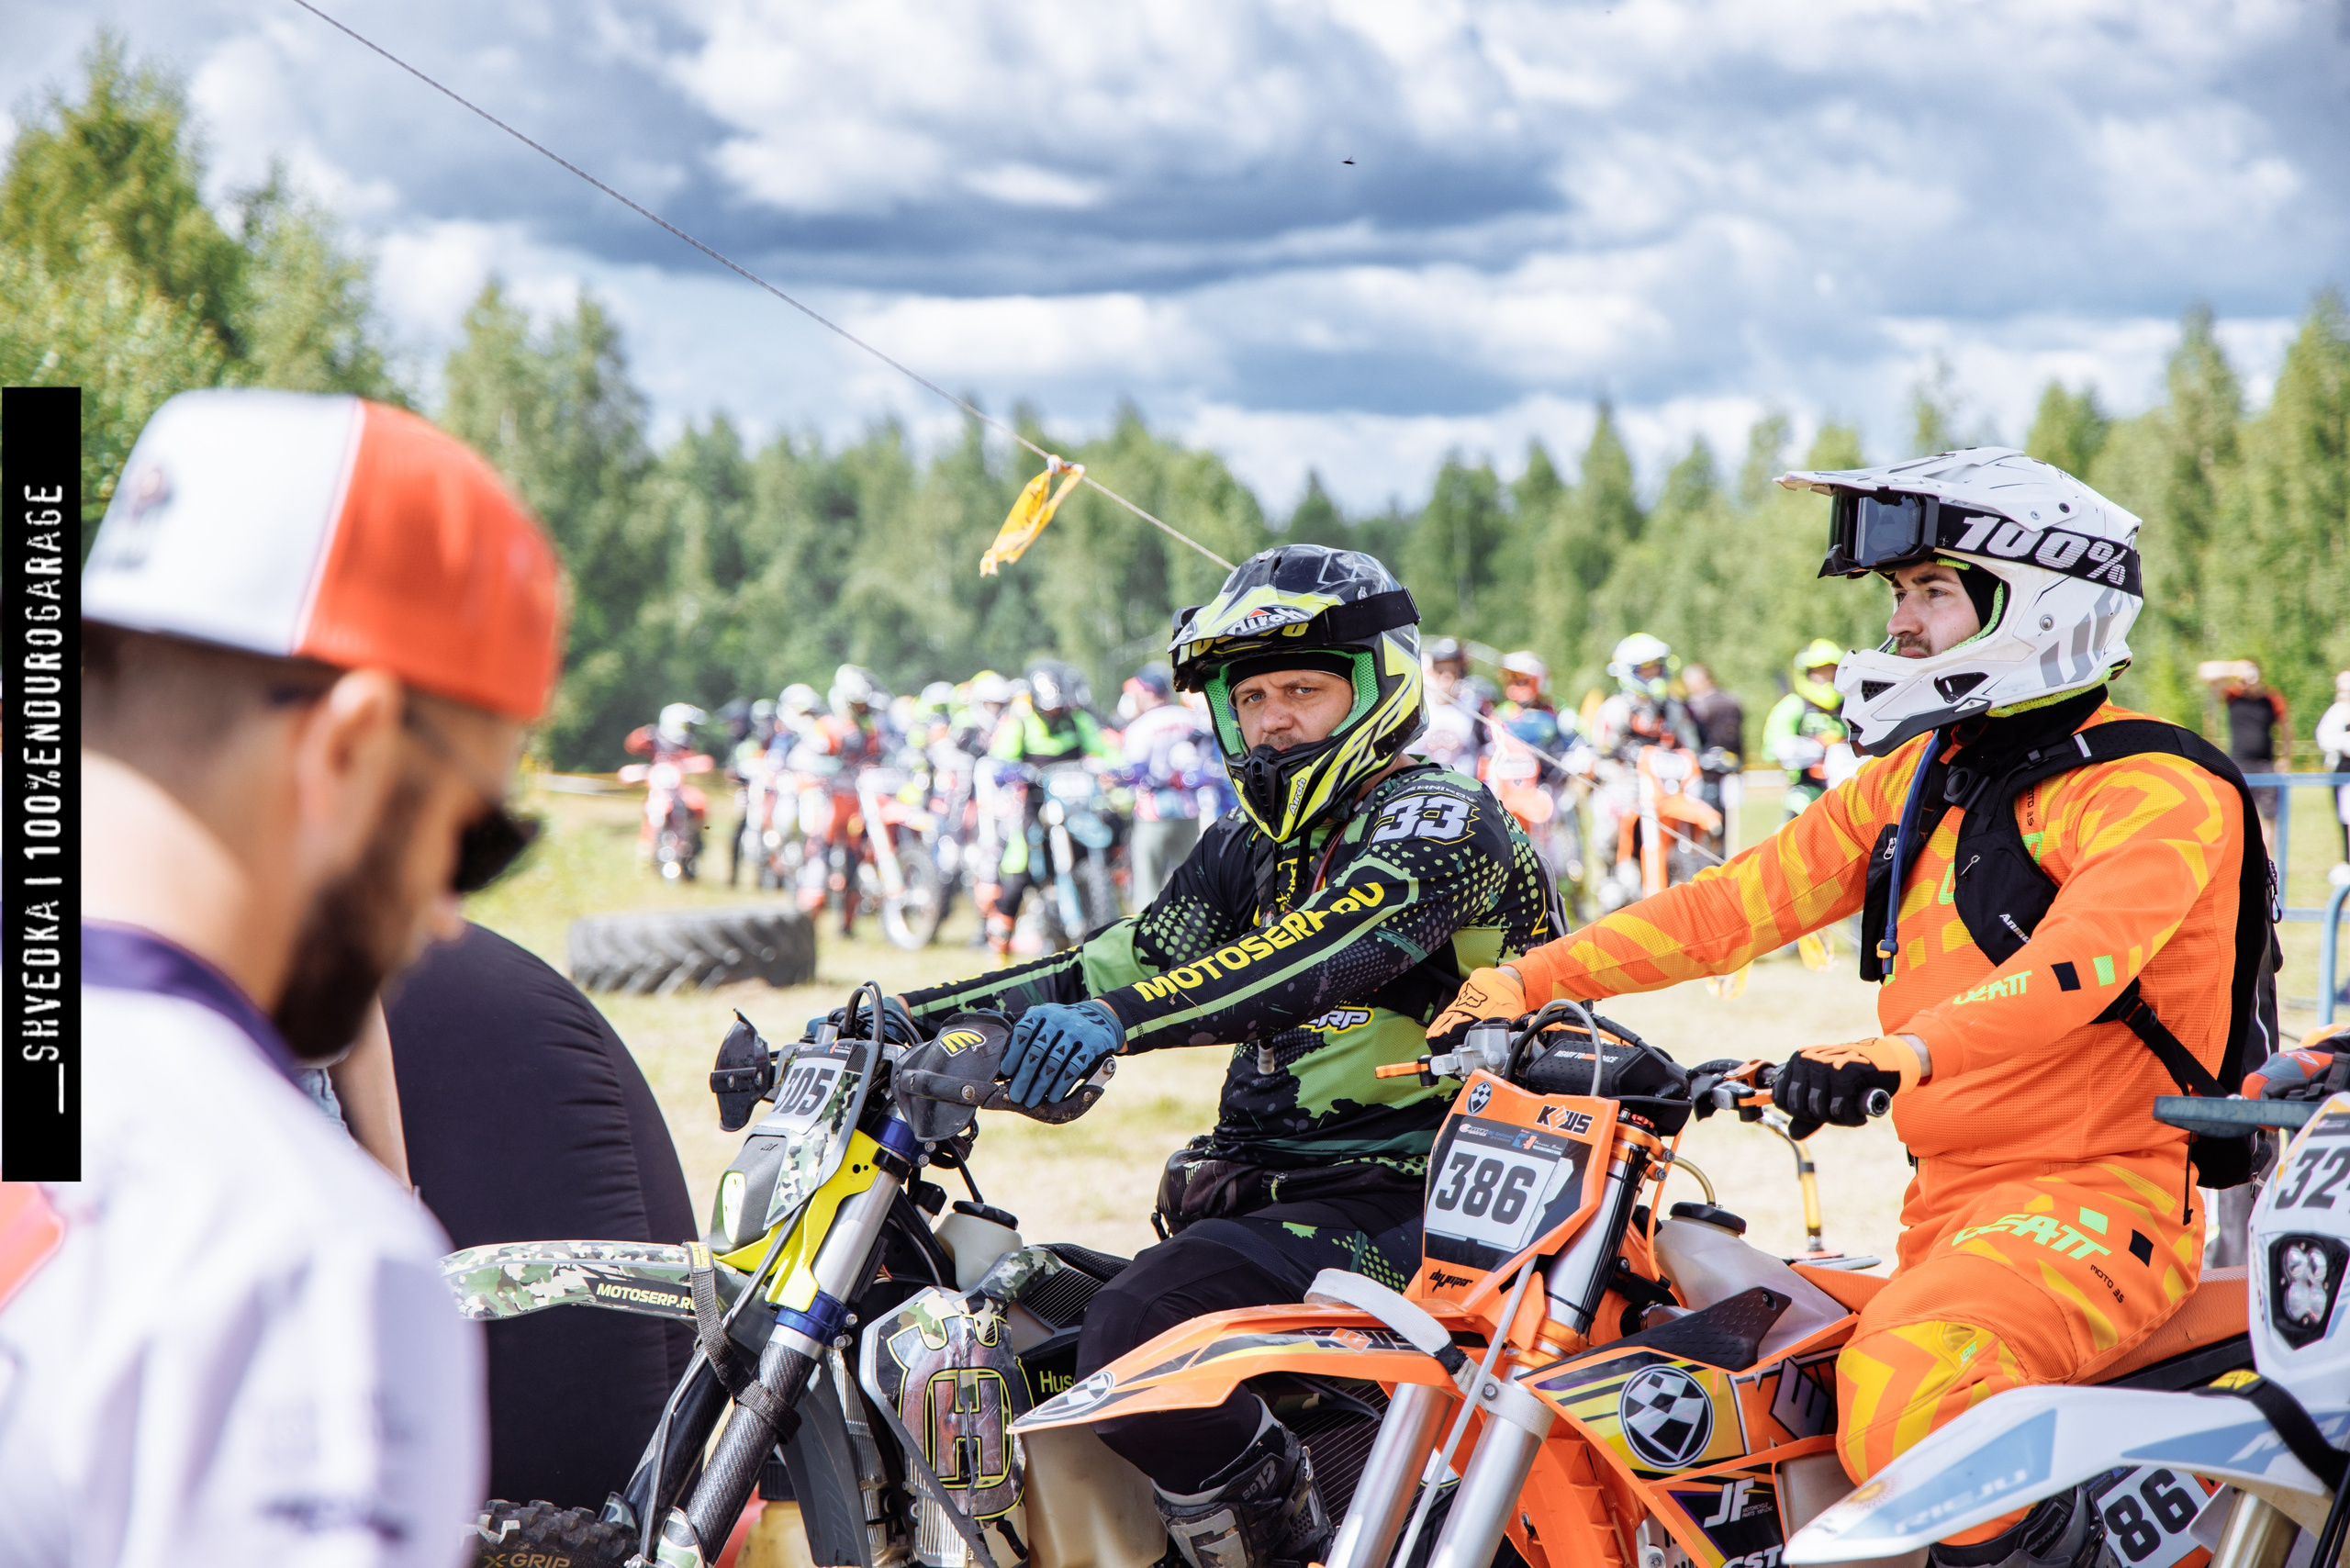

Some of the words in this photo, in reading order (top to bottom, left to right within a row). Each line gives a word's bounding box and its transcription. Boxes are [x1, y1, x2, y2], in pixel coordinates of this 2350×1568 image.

[1954, 515, 2128, 587] 100%
[1232, 607, 1309, 634] Airoh
[1288, 777, 1307, 817] Airoh
[1371, 795, 1470, 844] 33
[1435, 1151, 1538, 1226] 386
[2275, 1147, 2350, 1210] 32
[1951, 1214, 2112, 1260] LEATT
[2089, 1263, 2115, 1289] MOTO
[1039, 1370, 1077, 1394] Hus
[1703, 1476, 1755, 1529] JF
[2104, 1468, 2199, 1562] 86
